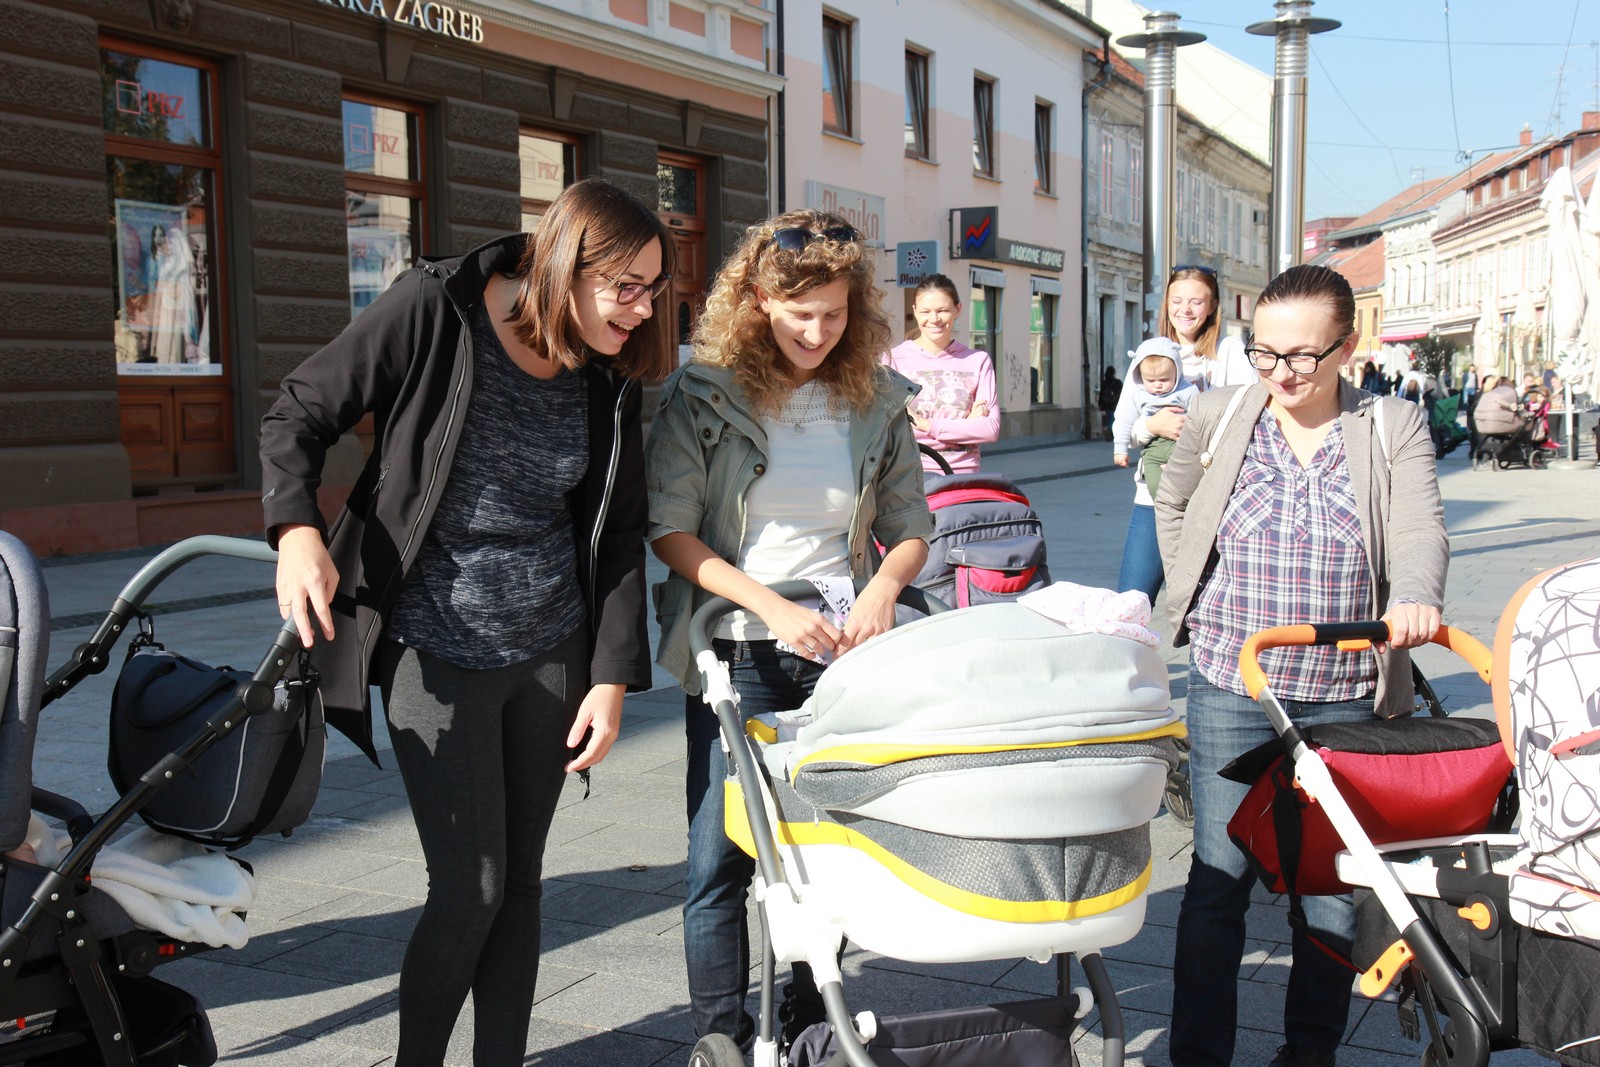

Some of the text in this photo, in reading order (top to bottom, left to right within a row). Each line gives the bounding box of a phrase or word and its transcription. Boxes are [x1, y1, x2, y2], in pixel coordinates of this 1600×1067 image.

[394, 0, 484, 44] ZAGREB
[147, 90, 185, 119] PBZ
[372, 132, 400, 155] PBZ
[537, 161, 560, 181] PBZ
[900, 272, 926, 285] Plani
